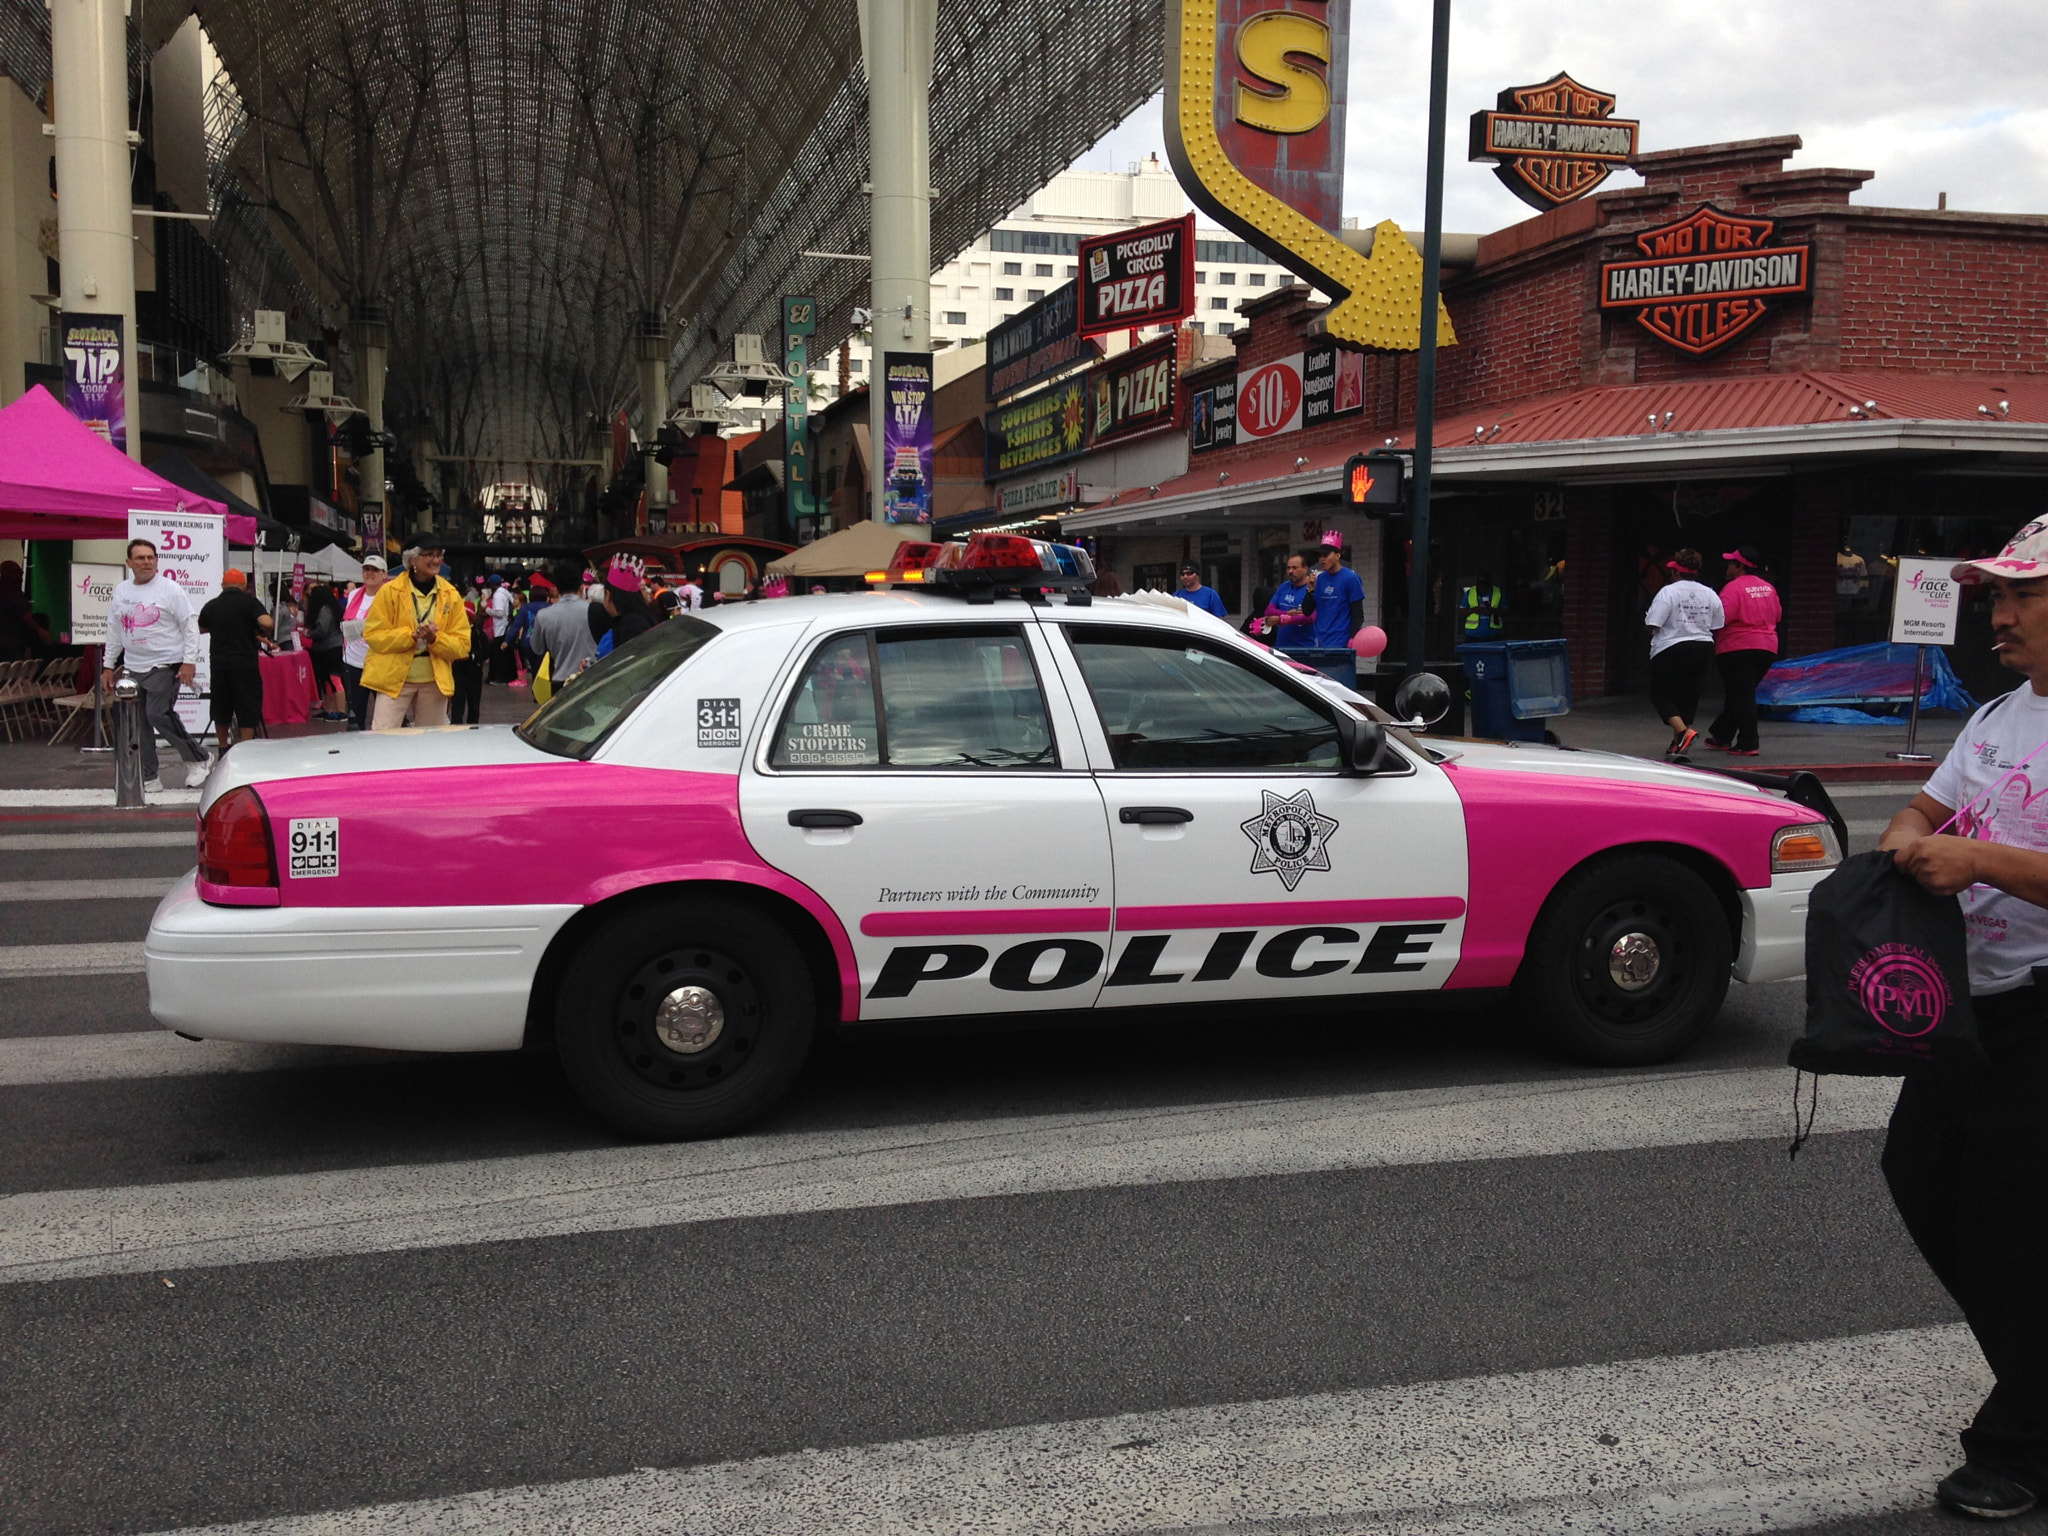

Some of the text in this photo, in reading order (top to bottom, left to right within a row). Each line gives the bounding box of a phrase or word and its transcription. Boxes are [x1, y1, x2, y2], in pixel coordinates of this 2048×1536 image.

[1233, 9, 1331, 135] S
[1528, 84, 1600, 117] MOTOR
[1493, 118, 1632, 155] HARLEY-DAVIDSON
[1526, 157, 1597, 193] CYCLES
[1116, 232, 1175, 260] PICCADILLY
[1655, 217, 1753, 257] MOTOR
[1126, 253, 1164, 275] CIRCUS
[1611, 253, 1798, 300] HARLEY-DAVIDSON
[1099, 274, 1165, 316] PIZZA
[790, 304, 811, 324] El
[1654, 299, 1750, 346] CYCLES
[1308, 351, 1331, 373] Leather
[1117, 360, 1169, 420] PIZZA
[1216, 383, 1235, 401] Watches
[1304, 373, 1334, 396] Sunglasses
[787, 334, 806, 482] PORTAL
[891, 391, 926, 406] NON STOP
[1249, 369, 1284, 431] $10
[1307, 399, 1329, 418] Scarves
[895, 404, 922, 426] 4TH
[1000, 393, 1061, 432] SOUVENIRS
[1006, 418, 1054, 448] T-SHIRTS
[1215, 424, 1233, 443] Jewelry
[1000, 436, 1062, 470] BEVERAGES
[1003, 488, 1023, 508] PIZZA
[162, 520, 182, 528] WOMEN
[183, 521, 203, 529] ASKING
[160, 530, 192, 550] 3D
[89, 586, 113, 596] race
[188, 587, 206, 595] VISITS
[1920, 580, 1949, 591] race
[75, 629, 96, 637] Imaging
[1904, 629, 1944, 637] International
[1921, 620, 1946, 628] Resorts
[703, 700, 735, 708] DIAL
[700, 730, 739, 740] NON
[802, 723, 852, 738] CRIME
[788, 738, 867, 751] STOPPERS
[297, 821, 331, 830] DIAL
[1261, 805, 1320, 838] METROPOLITAN
[1286, 815, 1308, 829] VEGAS
[1274, 855, 1310, 869] POLICE
[291, 868, 337, 877] EMERGENCY
[878, 883, 1100, 903] Partners with the Community
[1976, 914, 2008, 930] VEGAS
[864, 923, 1447, 999] POLICE
[1848, 950, 1877, 991] PUEBLO
[1876, 984, 1936, 1018] PMI
